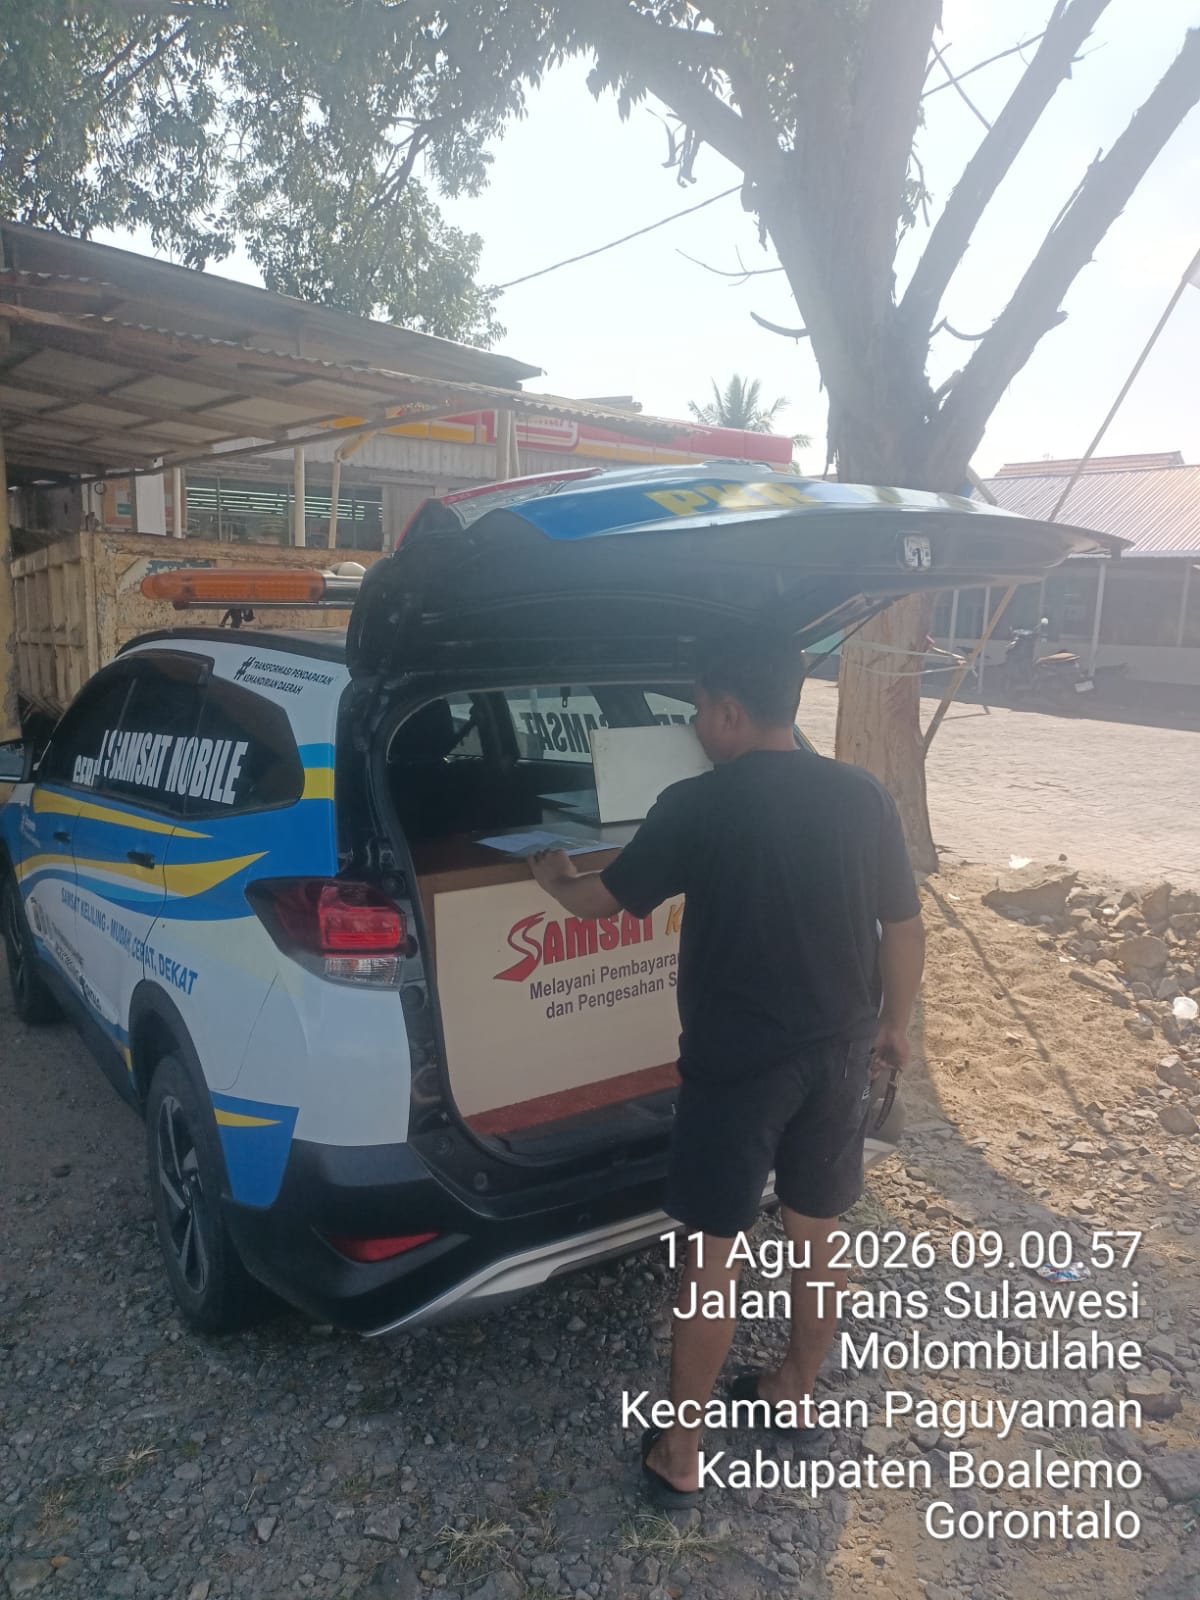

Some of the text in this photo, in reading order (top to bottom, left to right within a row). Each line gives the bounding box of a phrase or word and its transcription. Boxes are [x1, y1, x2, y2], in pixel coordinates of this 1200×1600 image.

[158, 953, 199, 996] DEKAT
[529, 952, 680, 1000] Melayani Pembayara
[545, 1000, 574, 1019] dan
[578, 977, 665, 1010] Pengesahan
